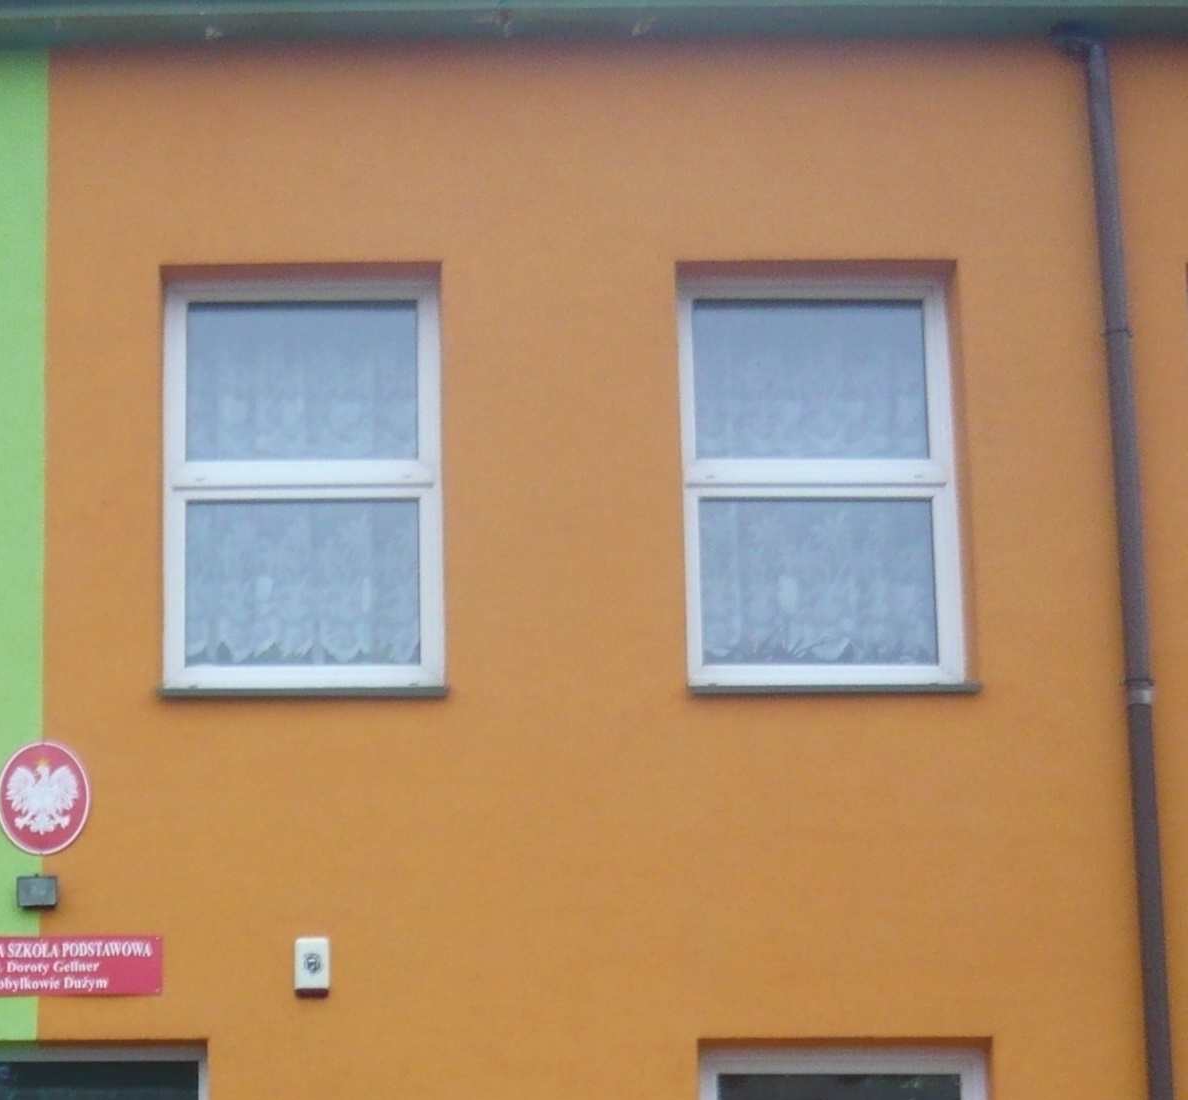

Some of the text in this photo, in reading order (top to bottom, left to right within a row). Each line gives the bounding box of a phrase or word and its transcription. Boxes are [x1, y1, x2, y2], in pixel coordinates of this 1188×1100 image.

[62, 941, 152, 957] PODSTAWOWA
[6, 961, 50, 976] Doroty
[52, 960, 100, 973] Gellner
[64, 976, 109, 992] Dużym
